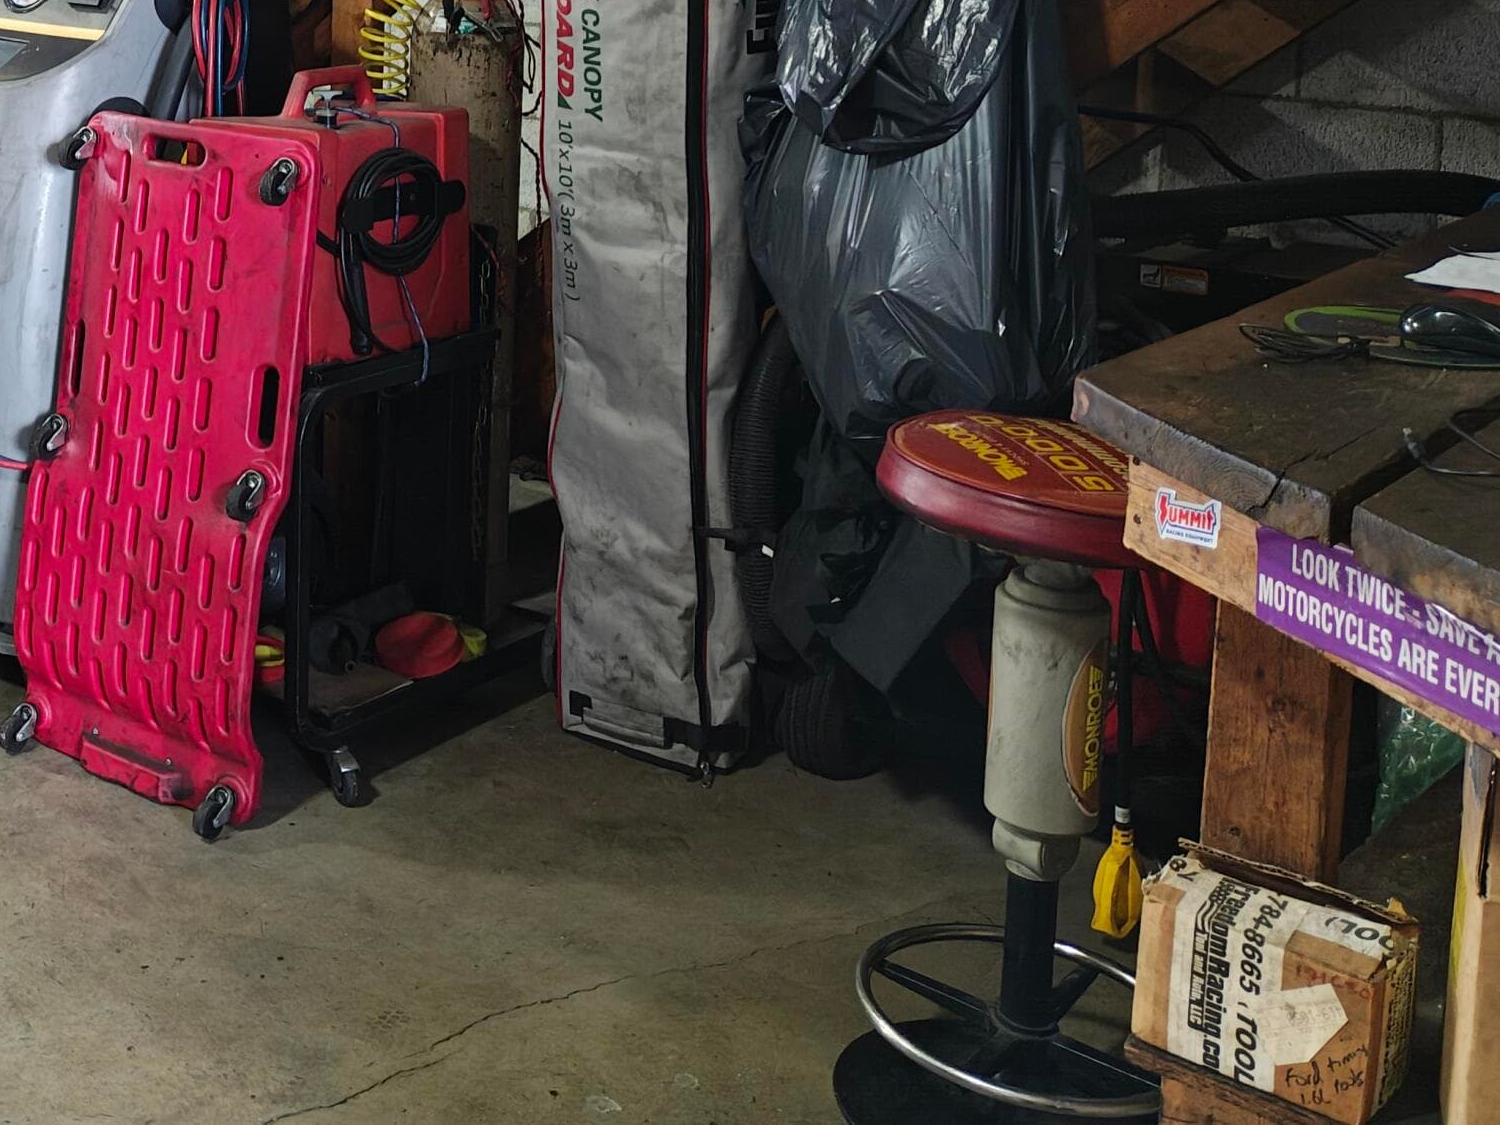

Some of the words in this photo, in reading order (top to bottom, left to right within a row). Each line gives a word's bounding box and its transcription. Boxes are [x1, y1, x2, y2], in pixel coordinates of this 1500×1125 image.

[580, 7, 603, 123] CANOPY
[1159, 494, 1214, 531] SUMMIT
[1258, 573, 1393, 663] MOTORCYCLES
[1397, 638, 1440, 685] ARE
[1291, 543, 1340, 593] LOOK
[1345, 565, 1405, 622] TWICE
[1426, 603, 1481, 656] SAVE
[1084, 673, 1103, 781] MONROE
[1285, 1061, 1321, 1088] Ford
